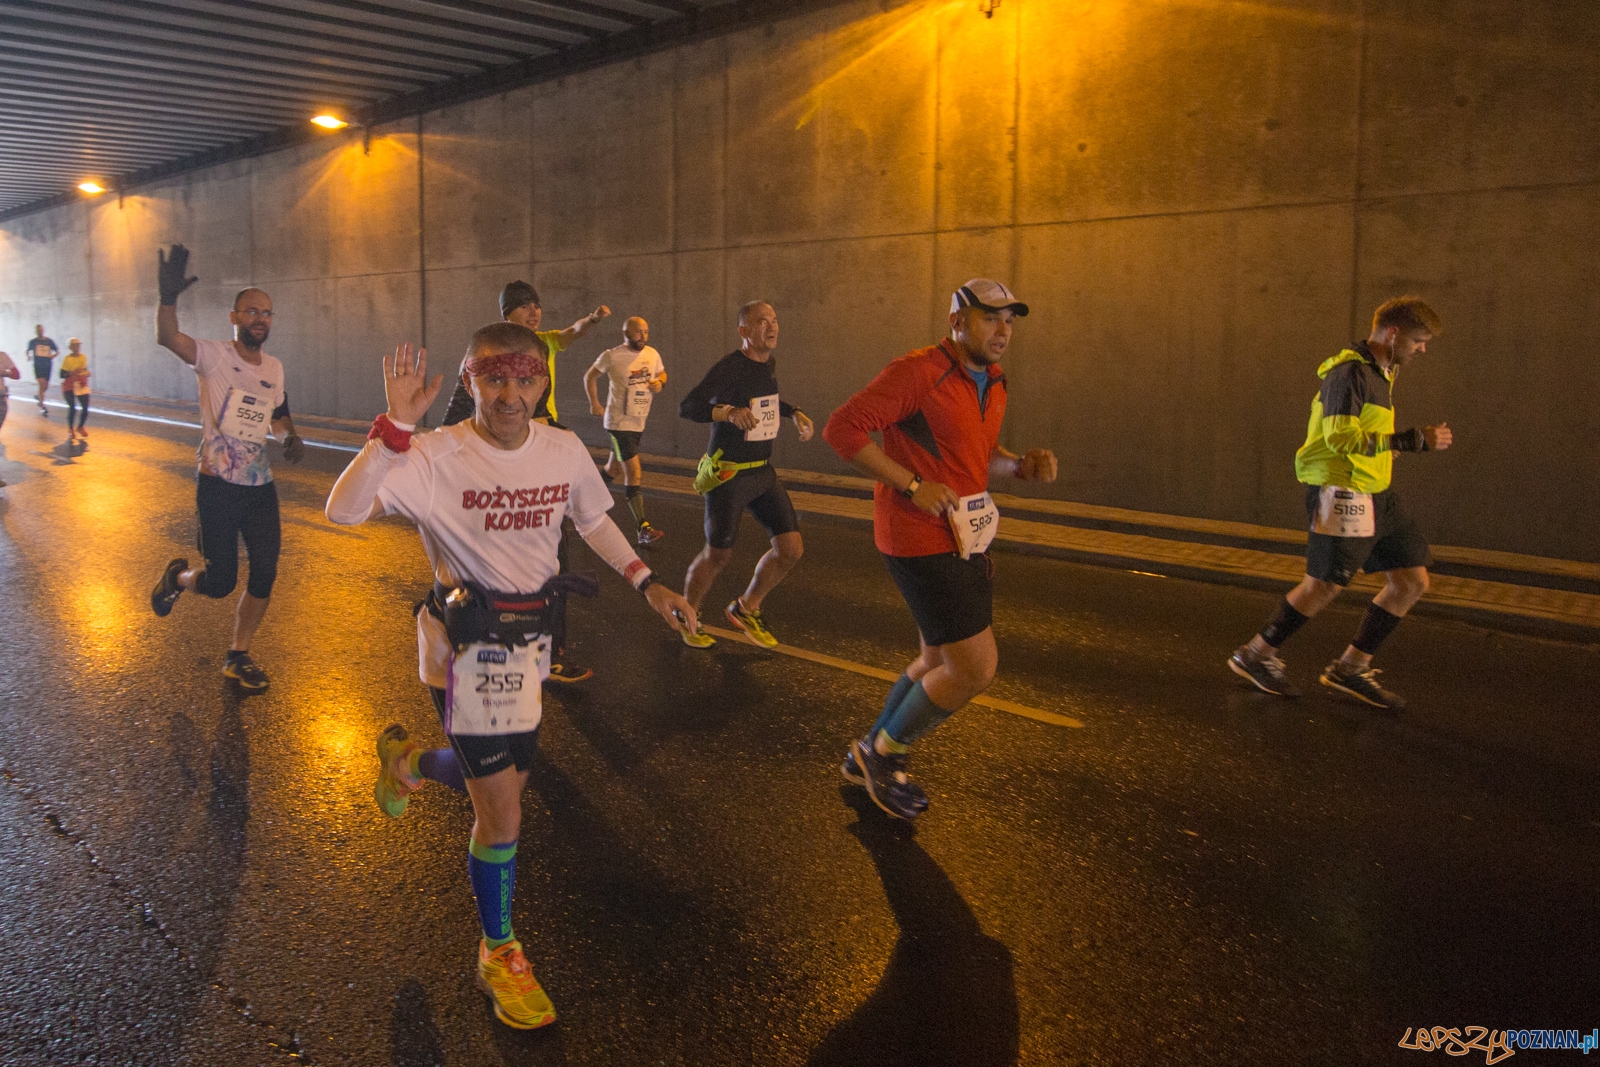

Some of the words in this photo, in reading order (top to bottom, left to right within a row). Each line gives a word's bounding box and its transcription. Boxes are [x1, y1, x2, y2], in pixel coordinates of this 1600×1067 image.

[236, 407, 265, 423] 5529
[761, 410, 775, 421] 703
[462, 484, 570, 510] BOŻYSZCZE
[485, 507, 555, 532] KOBIET
[1334, 504, 1366, 516] 5189
[475, 672, 525, 694] 2553
